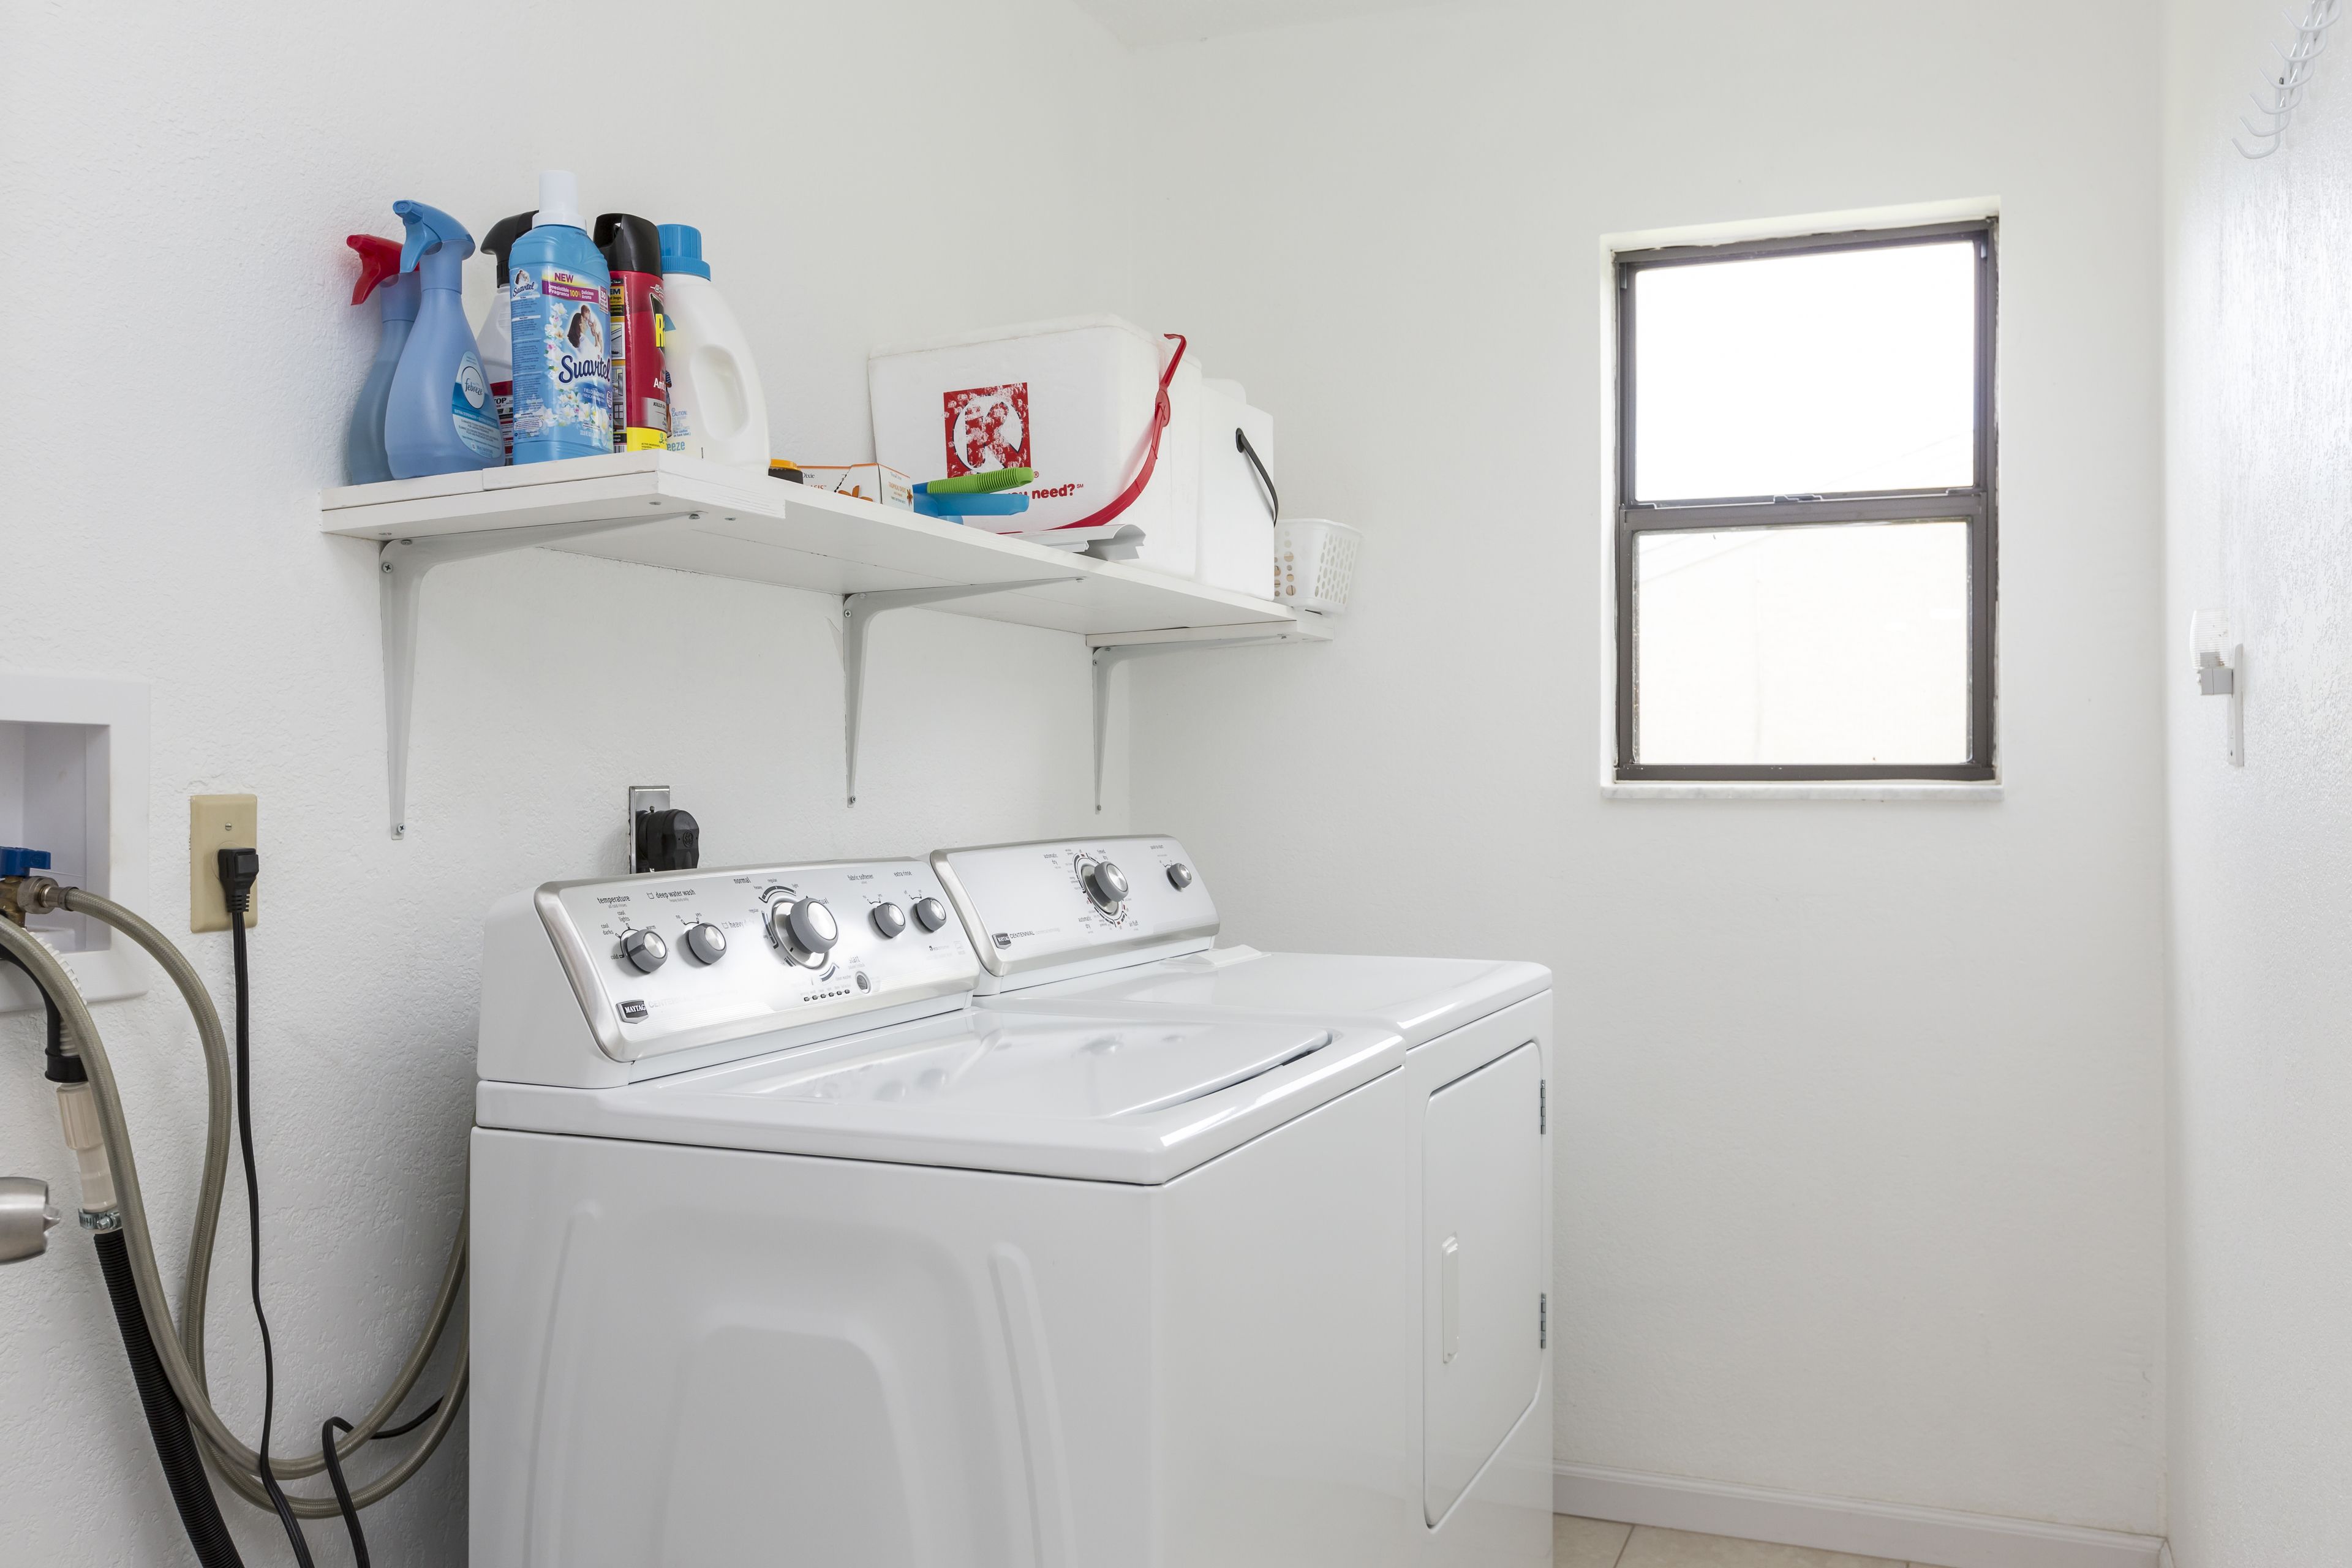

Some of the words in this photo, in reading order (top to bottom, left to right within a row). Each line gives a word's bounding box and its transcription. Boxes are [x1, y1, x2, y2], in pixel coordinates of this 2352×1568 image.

[554, 273, 574, 283] NEW
[513, 282, 535, 297] Suavitel
[549, 288, 570, 298] Fragrance
[570, 289, 582, 298] 100%
[558, 355, 611, 383] Suavitel
[464, 378, 483, 396] febreze
[667, 441, 685, 451] eeze
[1031, 483, 1076, 499] need?
[597, 895, 631, 905] temperature
[624, 1004, 646, 1014] MAYTAG
